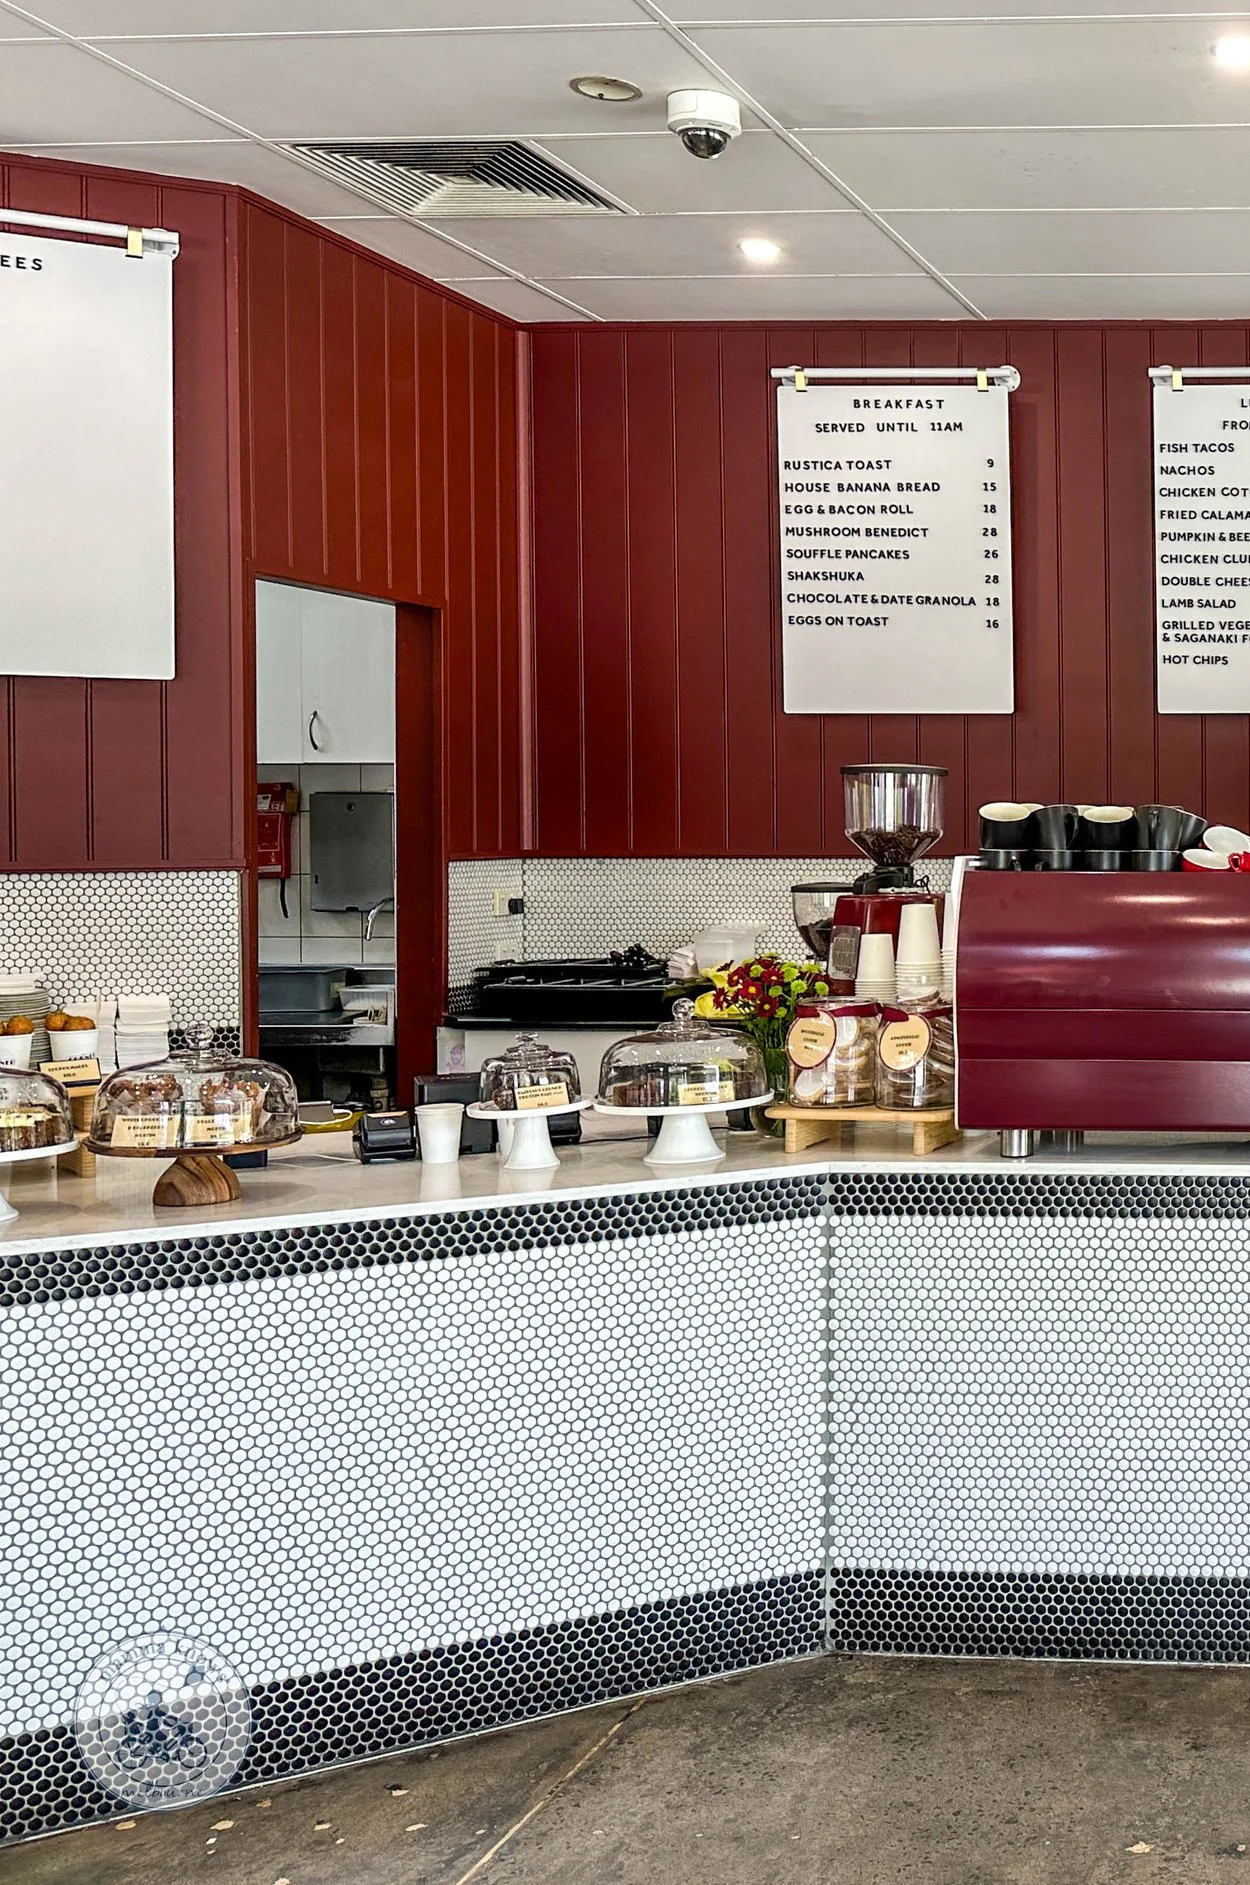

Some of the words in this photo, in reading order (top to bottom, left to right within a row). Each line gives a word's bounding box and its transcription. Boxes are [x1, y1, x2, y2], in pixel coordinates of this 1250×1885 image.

[0, 254, 43, 271] EES
[853, 398, 945, 410] BREAKFAST
[815, 422, 865, 434] SERVED
[876, 422, 918, 433] UNTIL
[930, 421, 963, 432] 11AM
[1159, 443, 1188, 454] FISH
[1191, 442, 1235, 453] TACOS
[783, 460, 843, 471] RUSTICA
[845, 459, 892, 471] TOAST
[986, 458, 995, 468] 9
[1160, 465, 1215, 476] NACHOS
[784, 482, 831, 493] HOUSE
[837, 482, 891, 493] BANANA
[896, 482, 941, 492] BREAD
[983, 482, 997, 492] 15
[1159, 487, 1216, 498] CHICKEN
[784, 504, 814, 515] EGG
[816, 504, 826, 515] &
[828, 504, 876, 515] BACON
[880, 504, 914, 515] ROLL
[983, 504, 997, 514] 18
[1159, 509, 1198, 520] FRIED
[785, 526, 861, 537] MUSHROOM
[865, 527, 929, 538] BENEDICT
[982, 527, 998, 537] 28
[1160, 531, 1216, 542] PUMPKIN
[1218, 531, 1227, 542] &
[786, 548, 843, 559] SOUFFLE
[845, 549, 910, 560] PANCAKES
[984, 549, 999, 559] 26
[1160, 554, 1219, 565] CHICKEN
[787, 570, 865, 582] SHAKSHUKA
[984, 574, 1000, 585] 28
[1161, 576, 1211, 587] DOUBLE
[786, 592, 869, 604] CHOCOLATE
[870, 594, 879, 605] &
[880, 594, 914, 605] DATE
[915, 595, 977, 607] GRANOLA
[985, 597, 1000, 607] 18
[1161, 598, 1195, 609] LAMB
[1197, 598, 1237, 609] SALAD
[788, 615, 822, 626] EGGS
[824, 615, 844, 626] ON
[846, 616, 889, 627] TOAST
[986, 619, 1000, 629] 16
[1161, 620, 1215, 631] GRILLED
[1162, 632, 1171, 643] &
[1174, 632, 1238, 644] SAGANAKI
[1162, 654, 1190, 665] HOT
[1192, 655, 1229, 666] CHIPS
